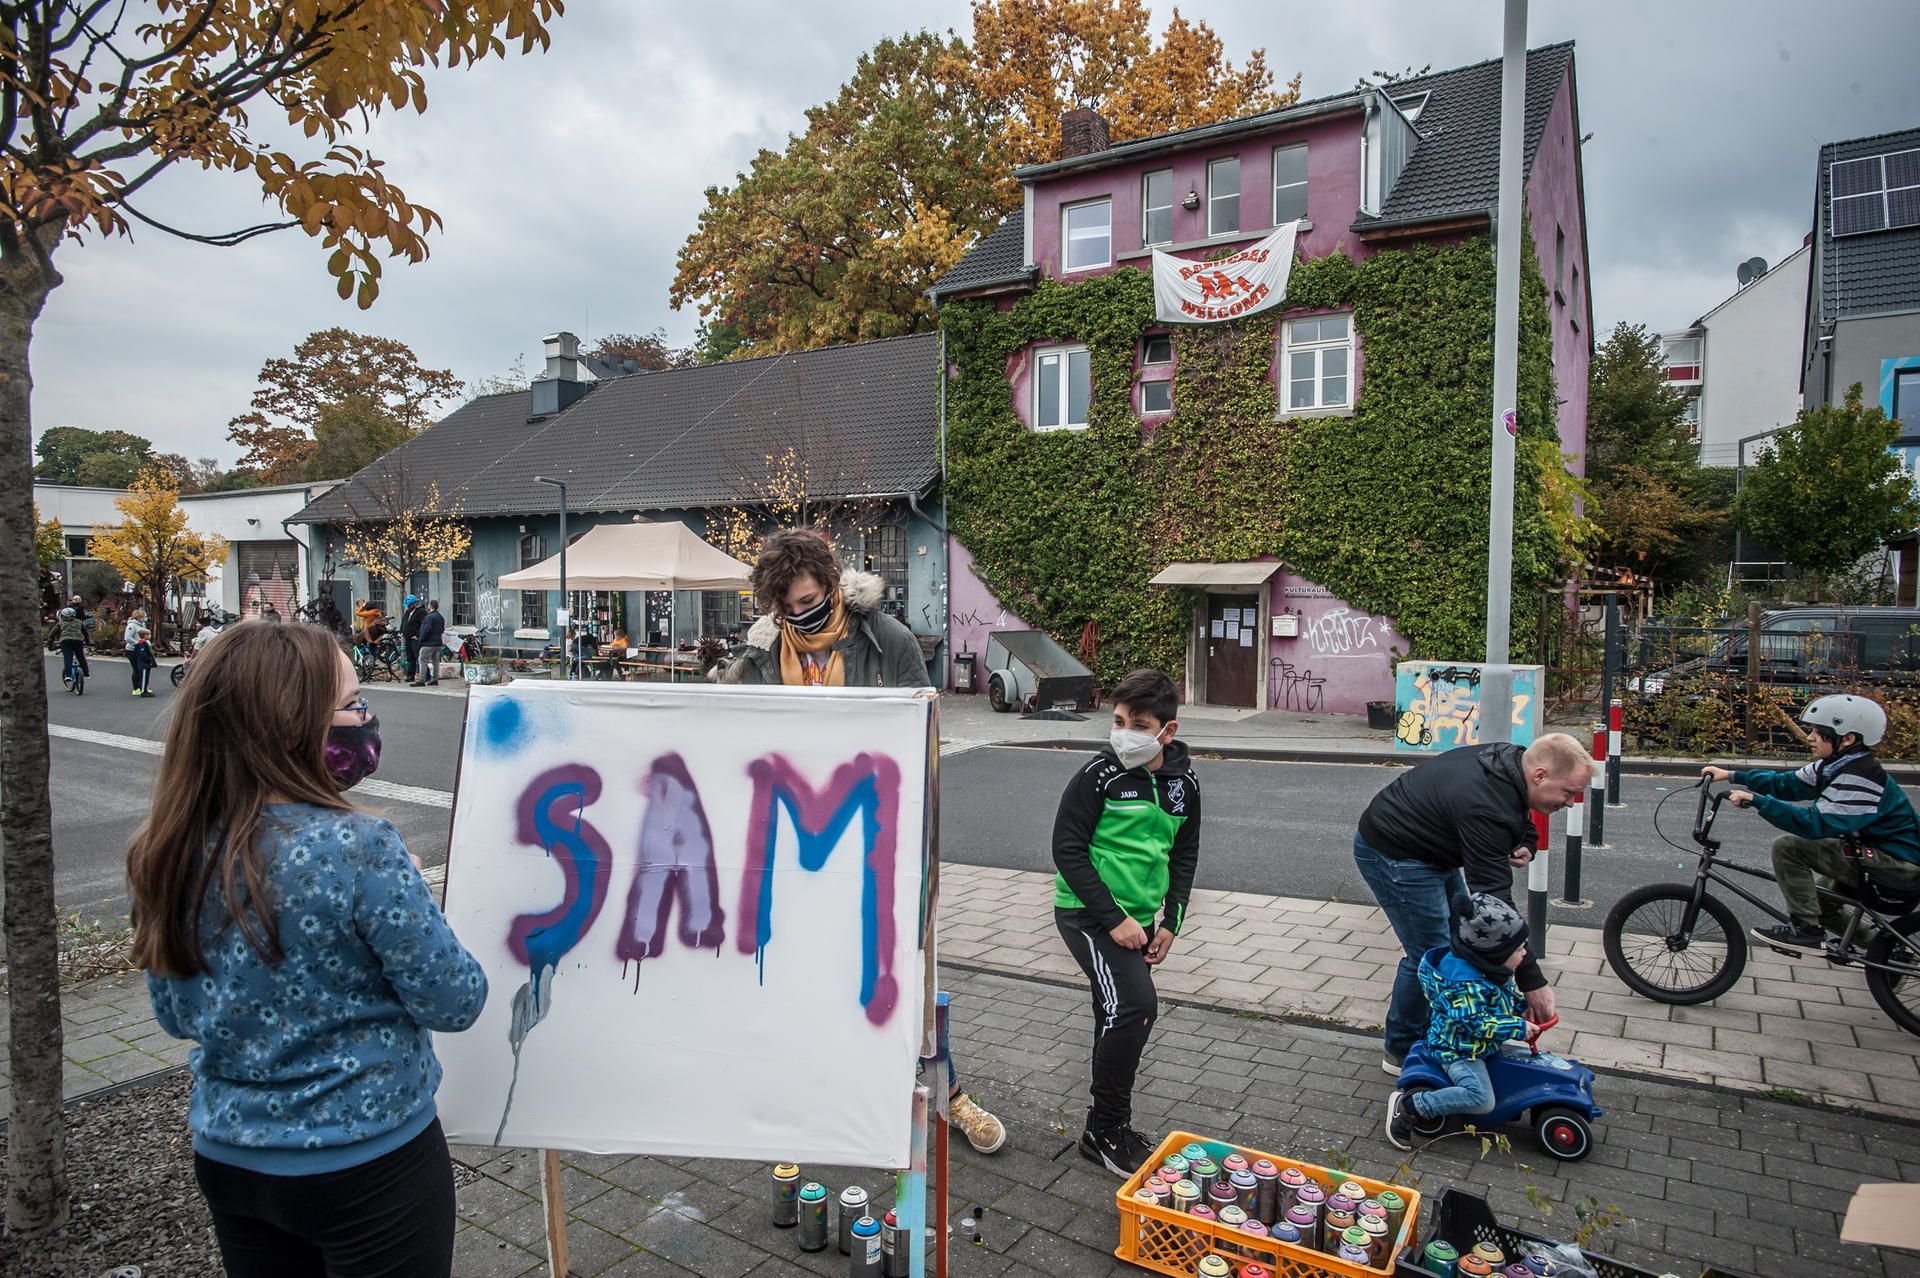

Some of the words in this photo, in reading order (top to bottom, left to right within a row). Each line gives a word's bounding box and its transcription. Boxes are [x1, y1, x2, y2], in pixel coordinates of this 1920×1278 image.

[1180, 283, 1270, 320] WELCOME
[1120, 791, 1138, 799] JAKO
[506, 751, 900, 1028] SAM
